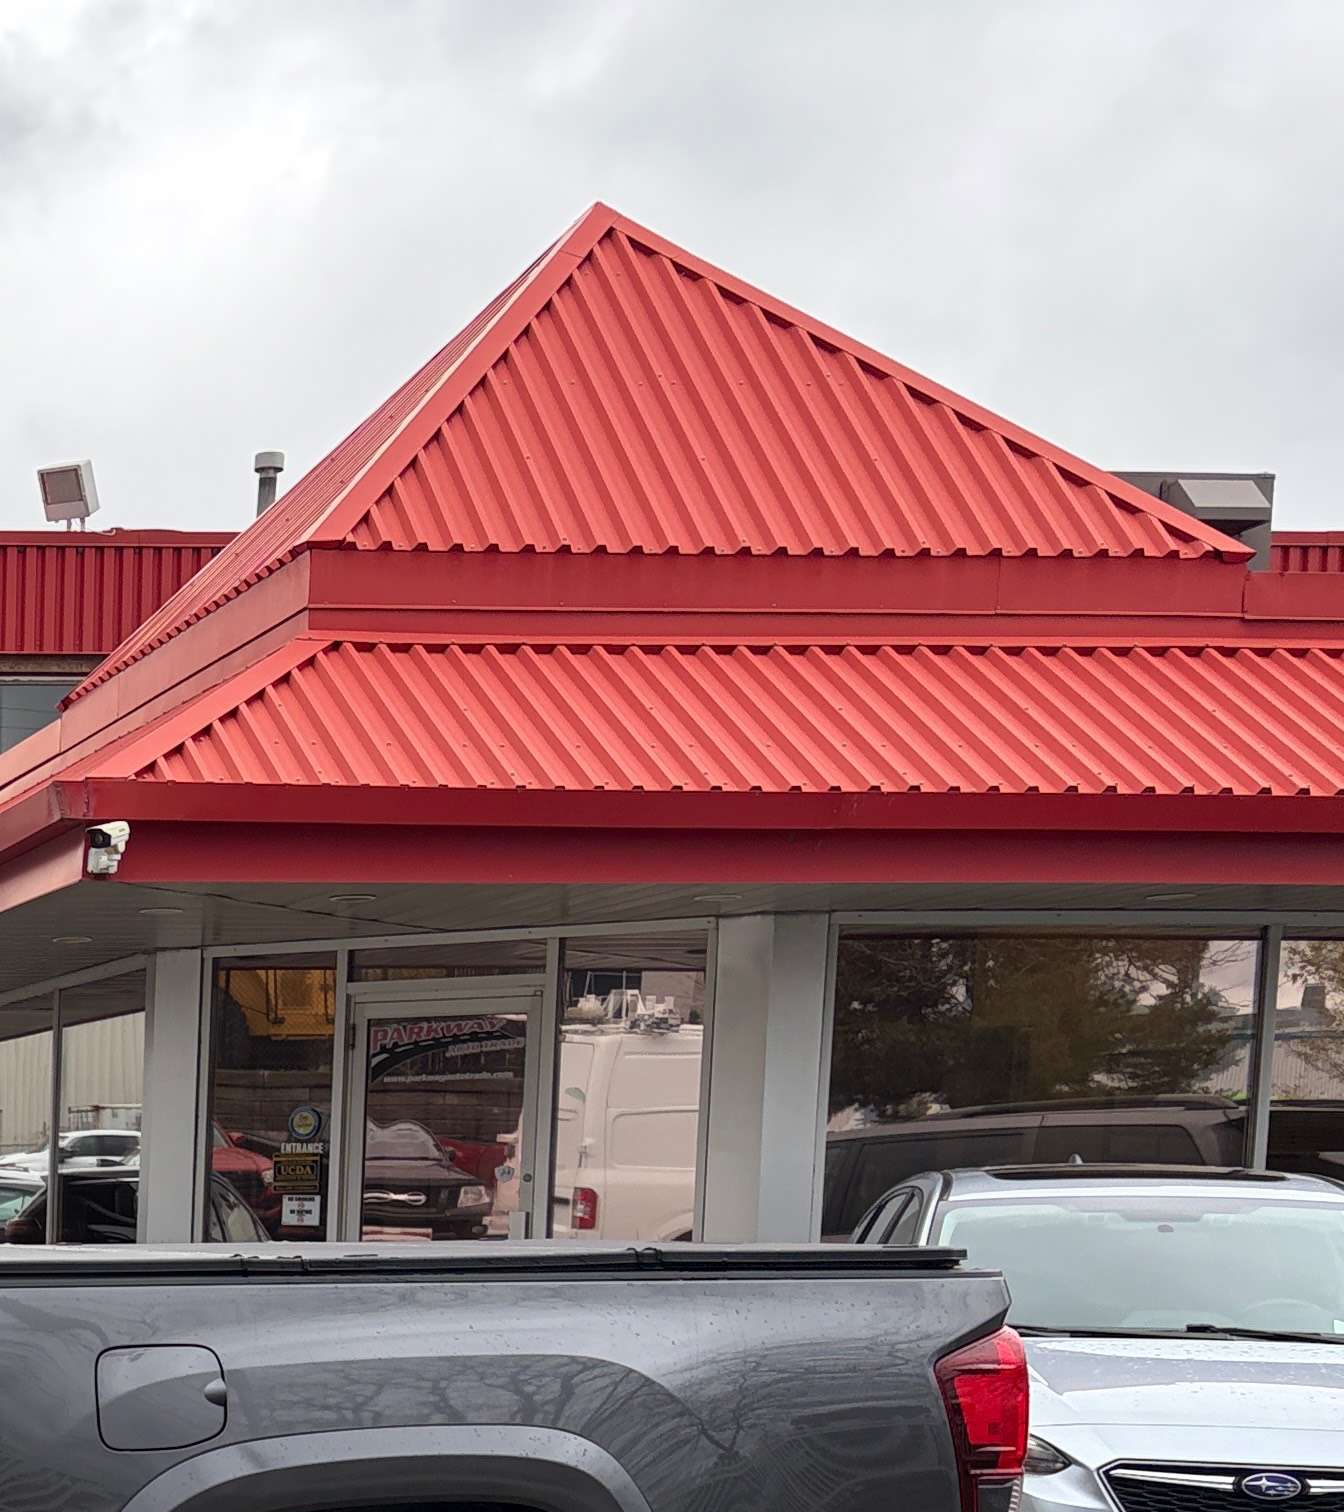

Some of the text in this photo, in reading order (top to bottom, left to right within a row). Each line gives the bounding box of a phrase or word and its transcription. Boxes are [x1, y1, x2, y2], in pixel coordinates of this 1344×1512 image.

[371, 1018, 506, 1051] PARKWAY
[281, 1142, 323, 1153] ENTRANCE
[281, 1165, 312, 1175] UCDA
